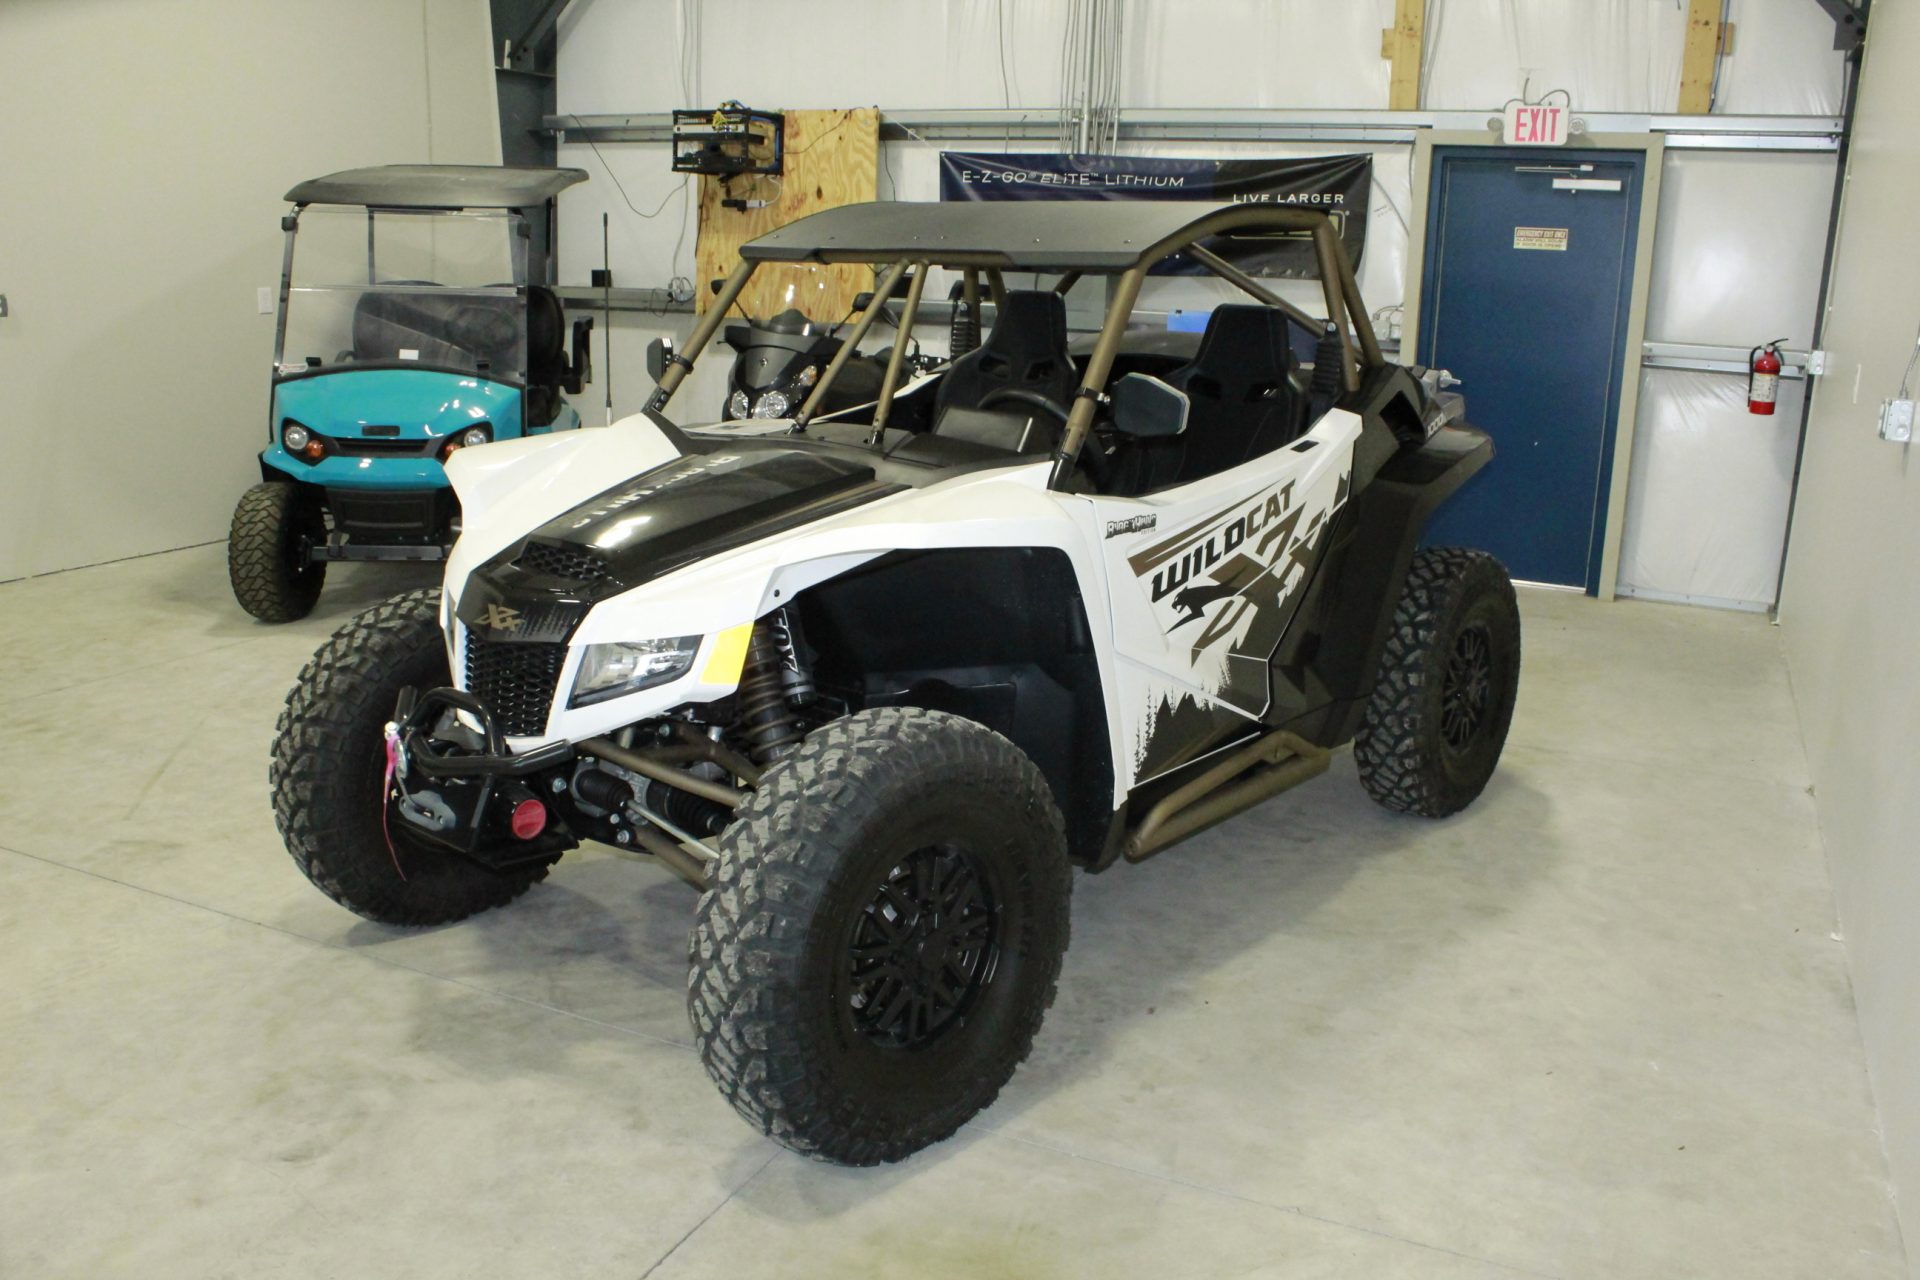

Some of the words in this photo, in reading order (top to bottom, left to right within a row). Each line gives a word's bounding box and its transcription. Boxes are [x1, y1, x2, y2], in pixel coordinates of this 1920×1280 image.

[1515, 108, 1560, 142] EXIT
[1105, 173, 1185, 187] LITHIUM
[1233, 194, 1270, 204] LIVE
[1277, 194, 1344, 204] LARGER
[1151, 478, 1297, 603] WILDCAT
[775, 608, 799, 673] FOX
